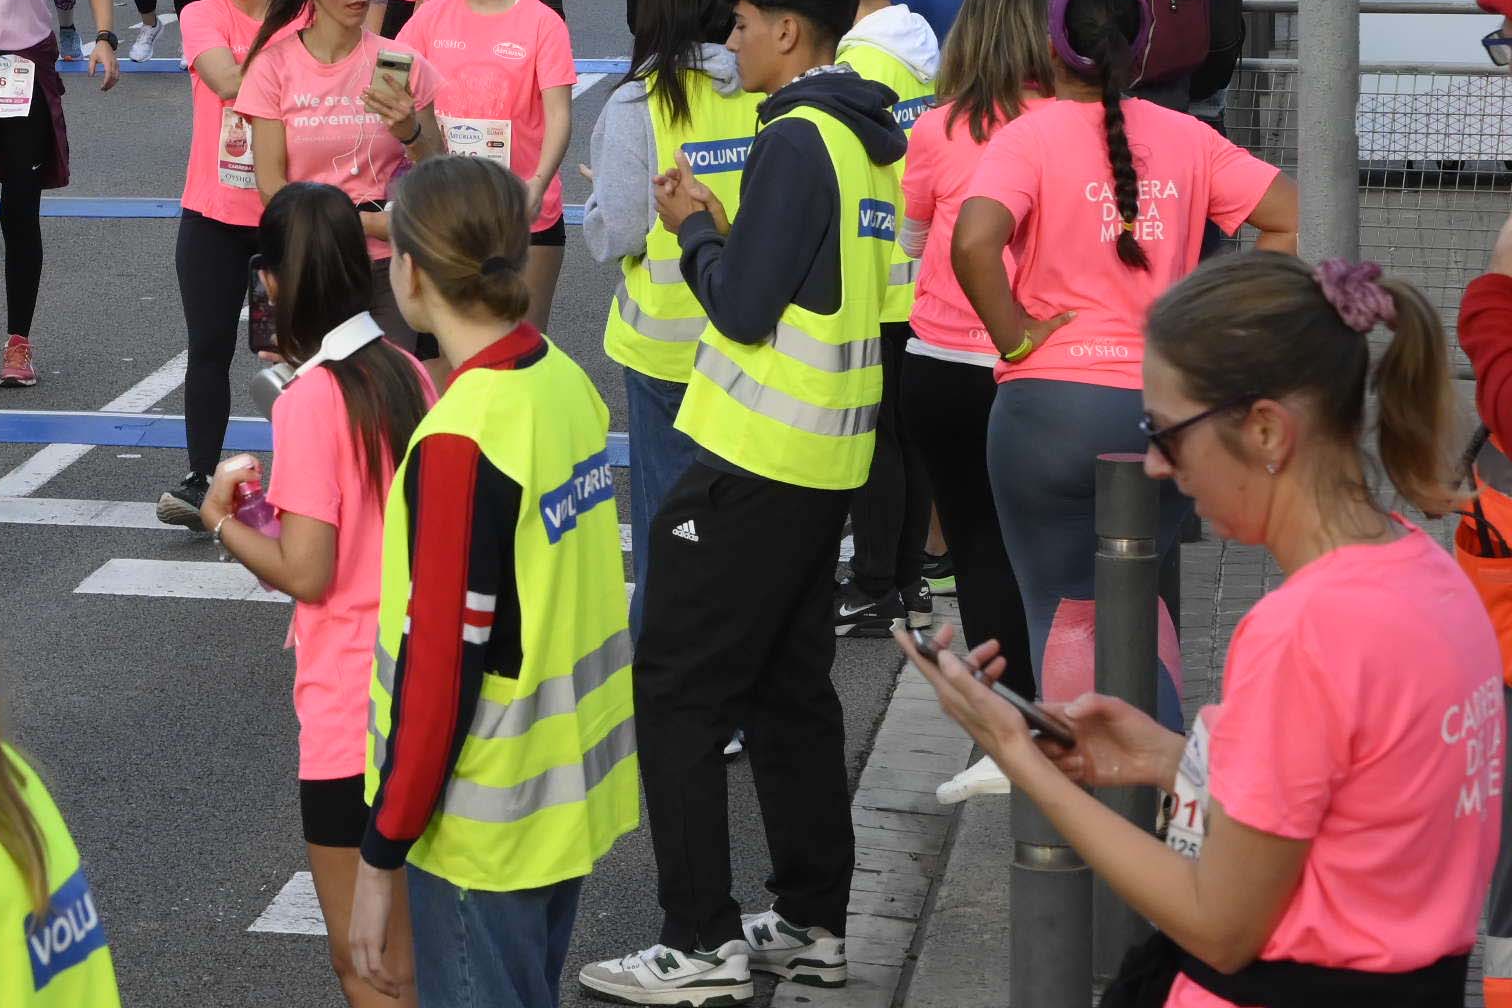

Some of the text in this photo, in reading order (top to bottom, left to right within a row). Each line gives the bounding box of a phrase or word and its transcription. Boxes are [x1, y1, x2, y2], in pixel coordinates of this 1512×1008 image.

[434, 39, 466, 50] OYSHO
[294, 94, 321, 107] We
[325, 96, 352, 107] are
[224, 173, 252, 184] OYSHO
[1084, 180, 1179, 202] CAERA
[1070, 344, 1128, 358] OYSHO
[672, 529, 700, 543] adidas
